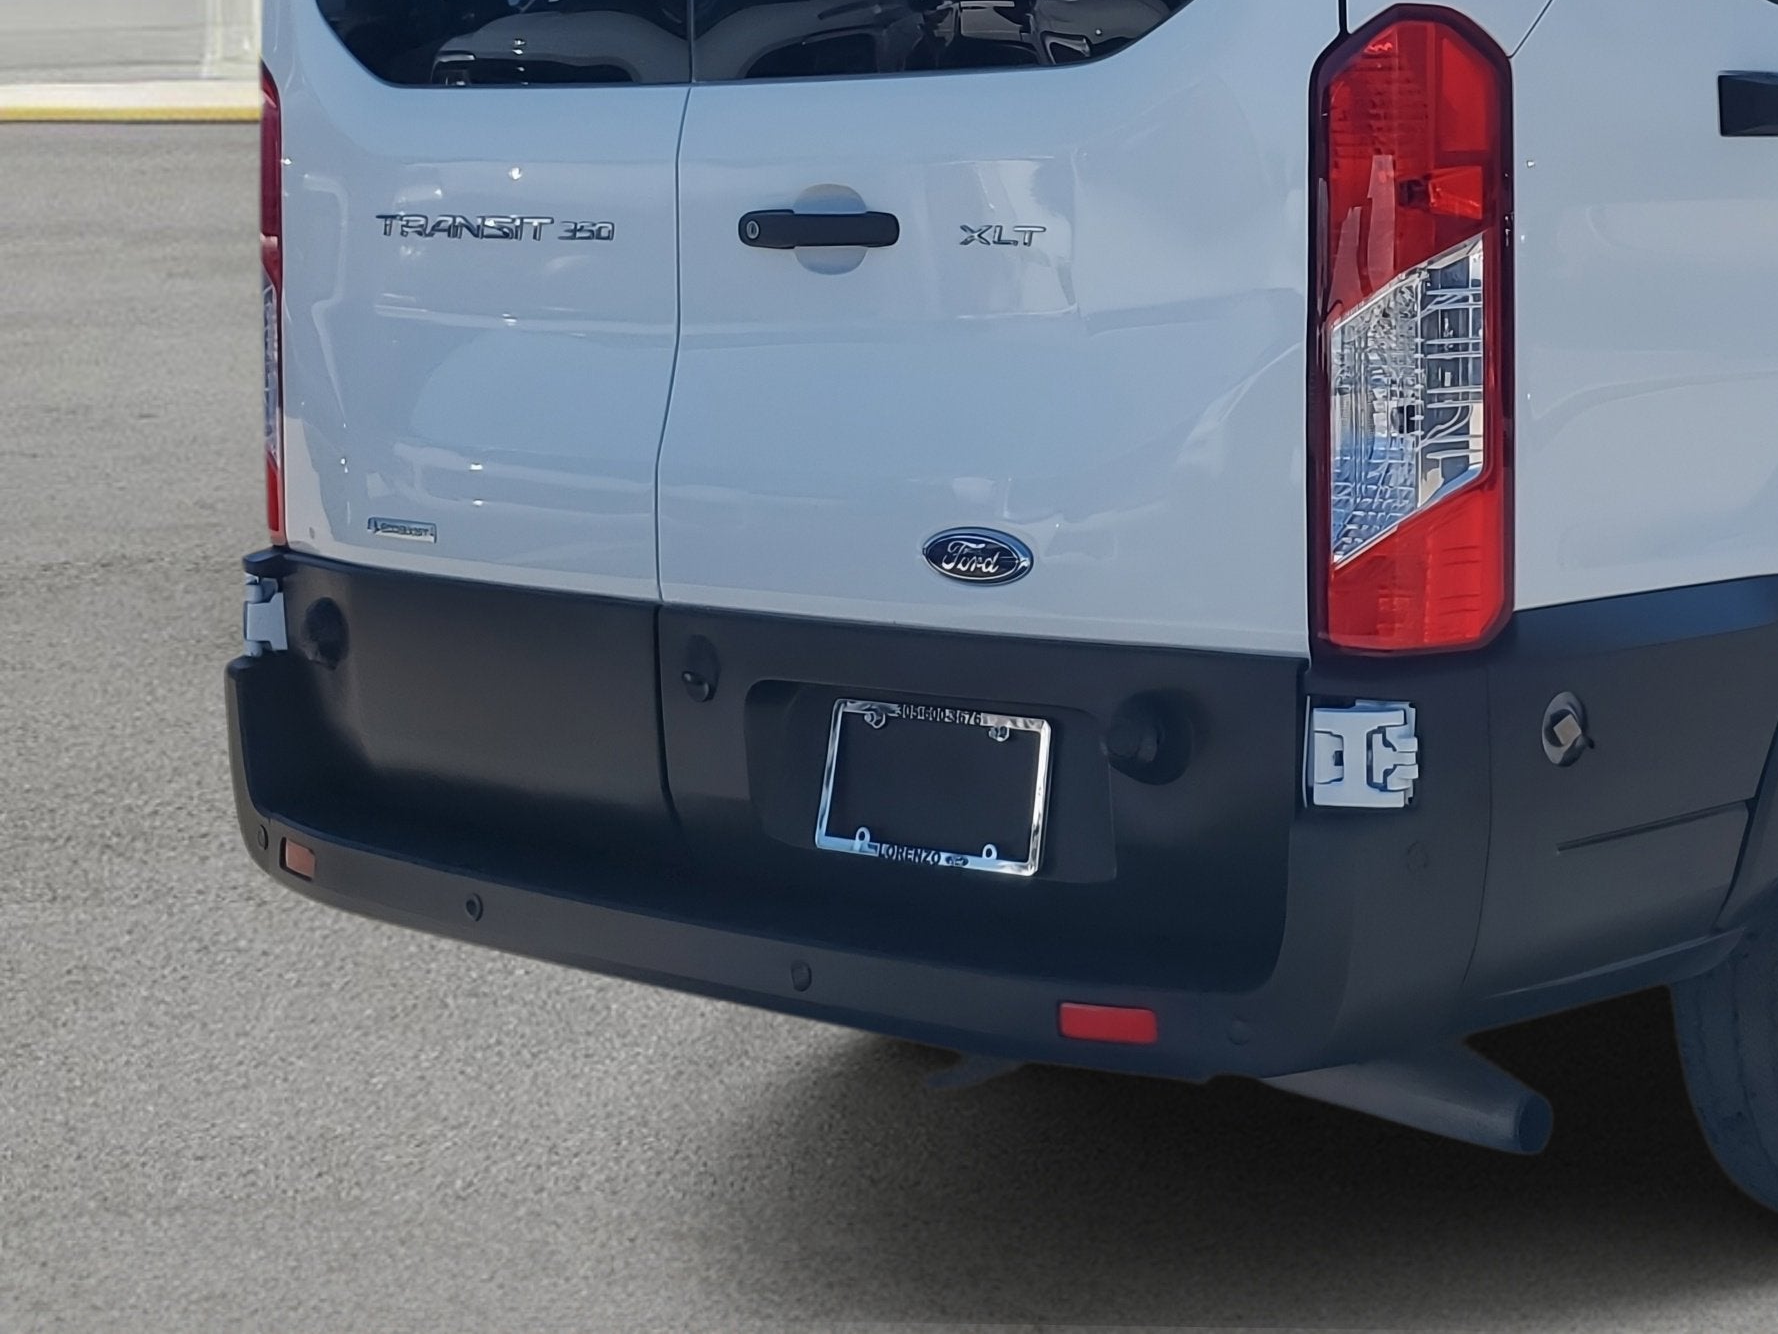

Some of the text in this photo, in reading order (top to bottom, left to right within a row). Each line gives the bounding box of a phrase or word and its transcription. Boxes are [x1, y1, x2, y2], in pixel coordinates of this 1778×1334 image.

[375, 214, 616, 242] TRANSIT 350
[959, 224, 1047, 247] XLT
[941, 540, 1001, 573] Ford
[879, 843, 942, 866] LORENZO
